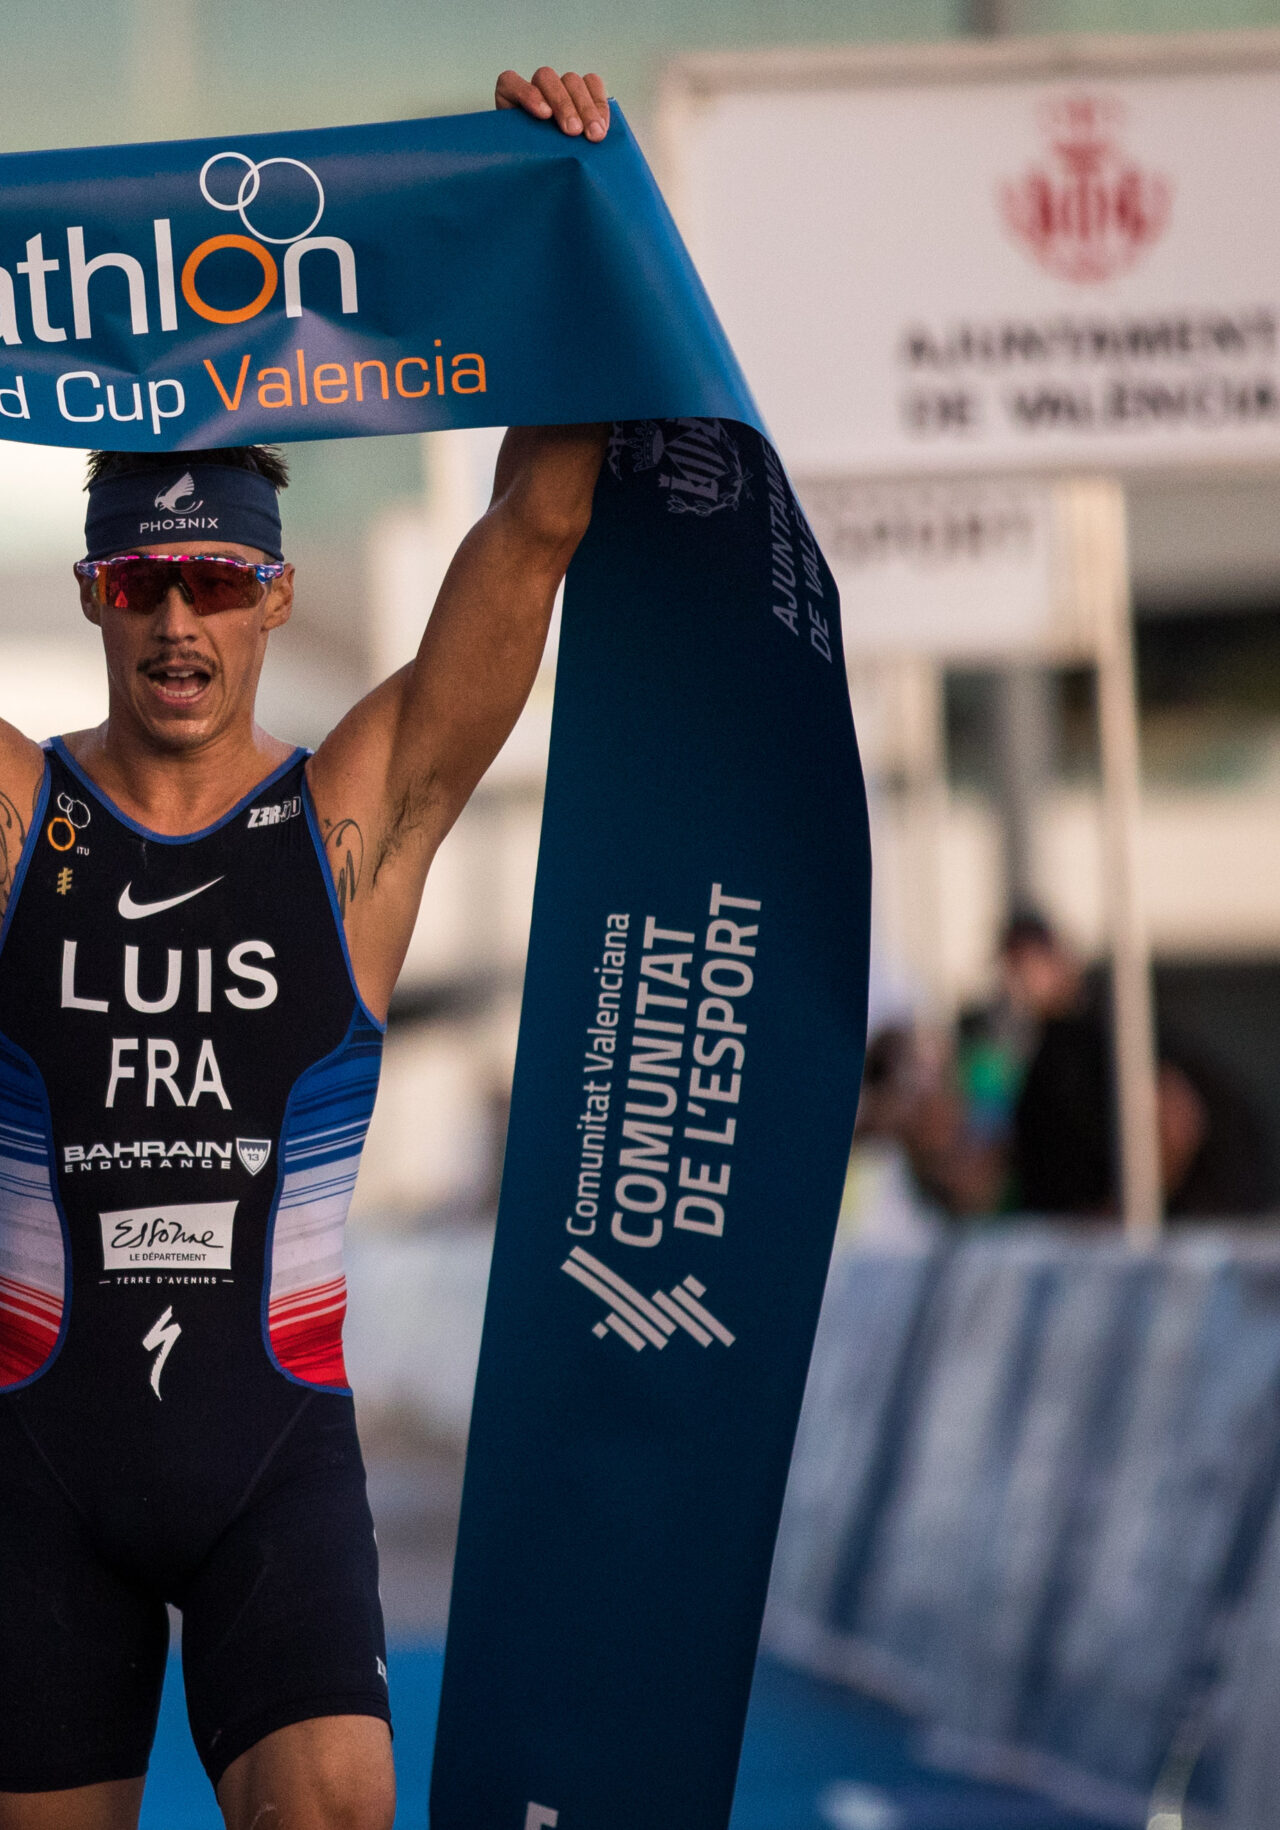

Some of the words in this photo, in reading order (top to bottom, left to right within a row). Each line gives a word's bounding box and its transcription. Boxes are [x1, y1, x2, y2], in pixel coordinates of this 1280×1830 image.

[55, 370, 186, 435] Cup
[203, 339, 489, 412] Valencia
[76, 846, 90, 856] ITU
[60, 939, 279, 1014] LUIS
[583, 912, 630, 1073] Valenciana
[684, 882, 763, 1146] L'ESPORT
[104, 1037, 233, 1111] FRA
[610, 915, 696, 1249] COMUNITAT
[64, 1141, 233, 1162] BAHRAIN
[64, 1160, 232, 1174] ENDURANCE
[247, 1153, 260, 1162] 13
[566, 1080, 612, 1237] Comunitat
[673, 1156, 732, 1238] DE
[116, 1276, 151, 1285] TERRE
[157, 1276, 217, 1285] D'AVENIRS
[129, 1253, 141, 1262] LE
[142, 1251, 207, 1262] DÉPARTEMENT
